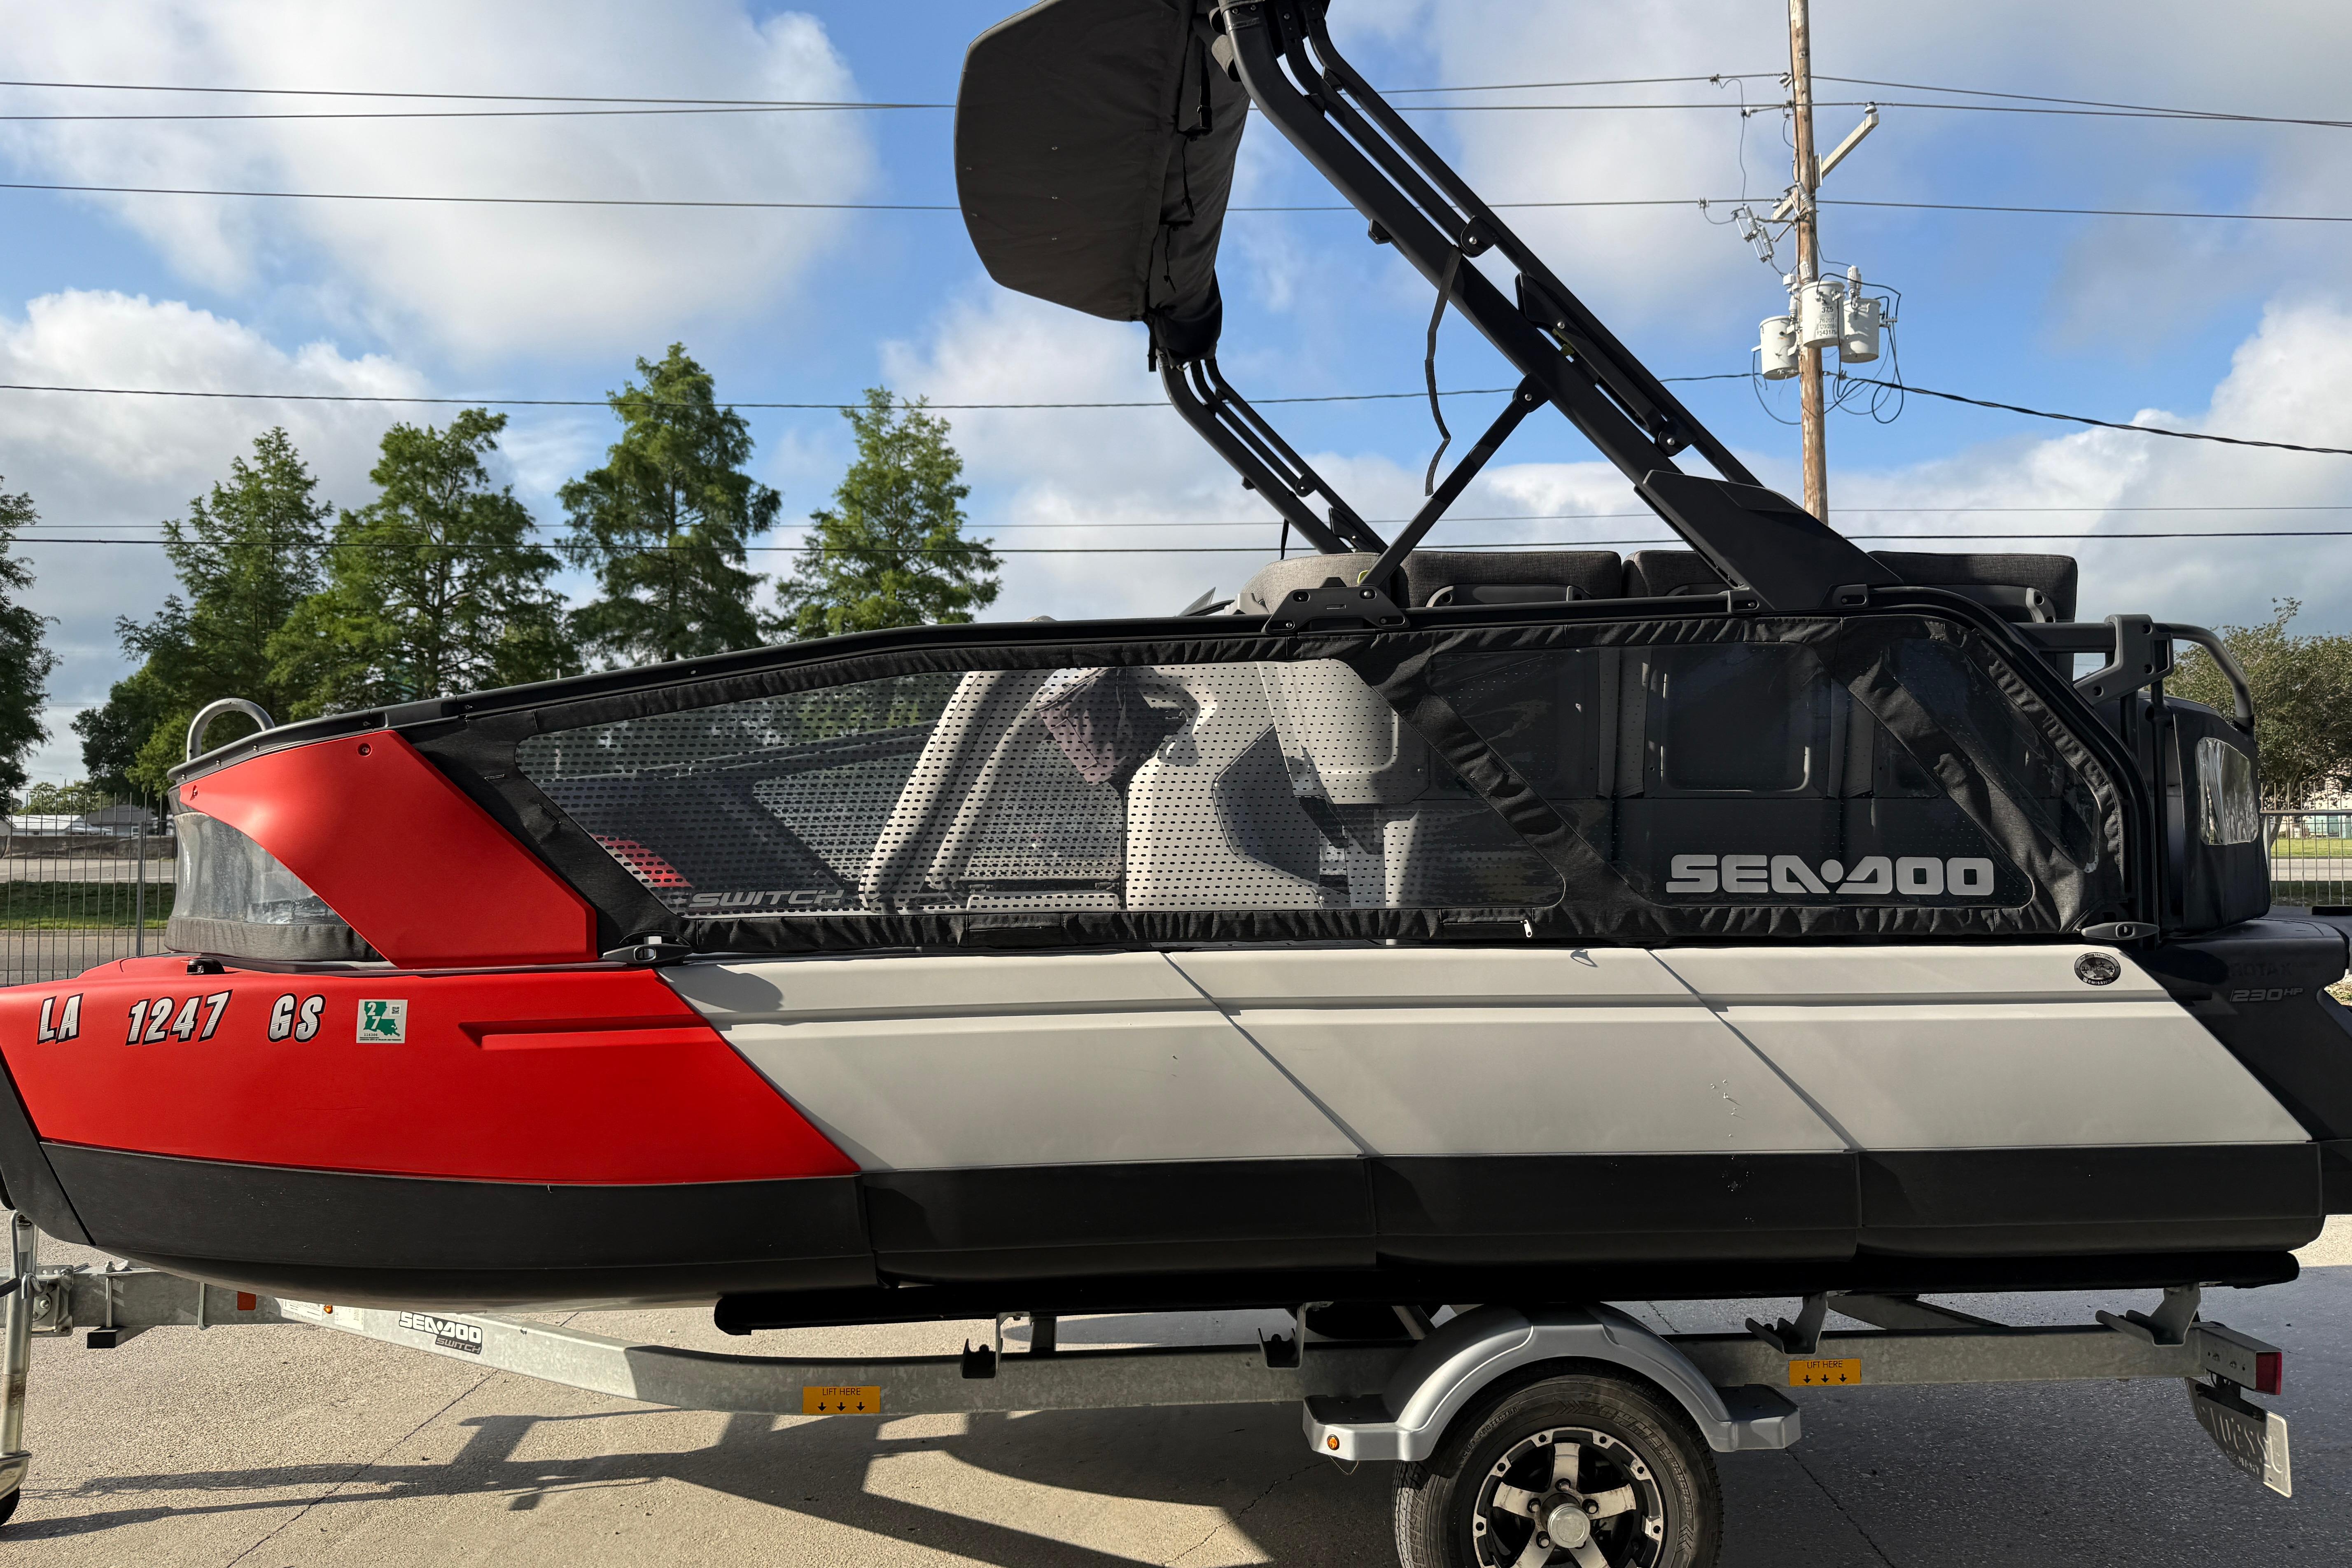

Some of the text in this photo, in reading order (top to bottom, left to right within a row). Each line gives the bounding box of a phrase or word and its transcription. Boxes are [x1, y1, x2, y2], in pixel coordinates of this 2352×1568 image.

[689, 889, 845, 907] SWITCH
[37, 989, 327, 1046] LA 1247 GS
[436, 1337, 481, 1353] SWITCH
[840, 1387, 861, 1395] HERE
